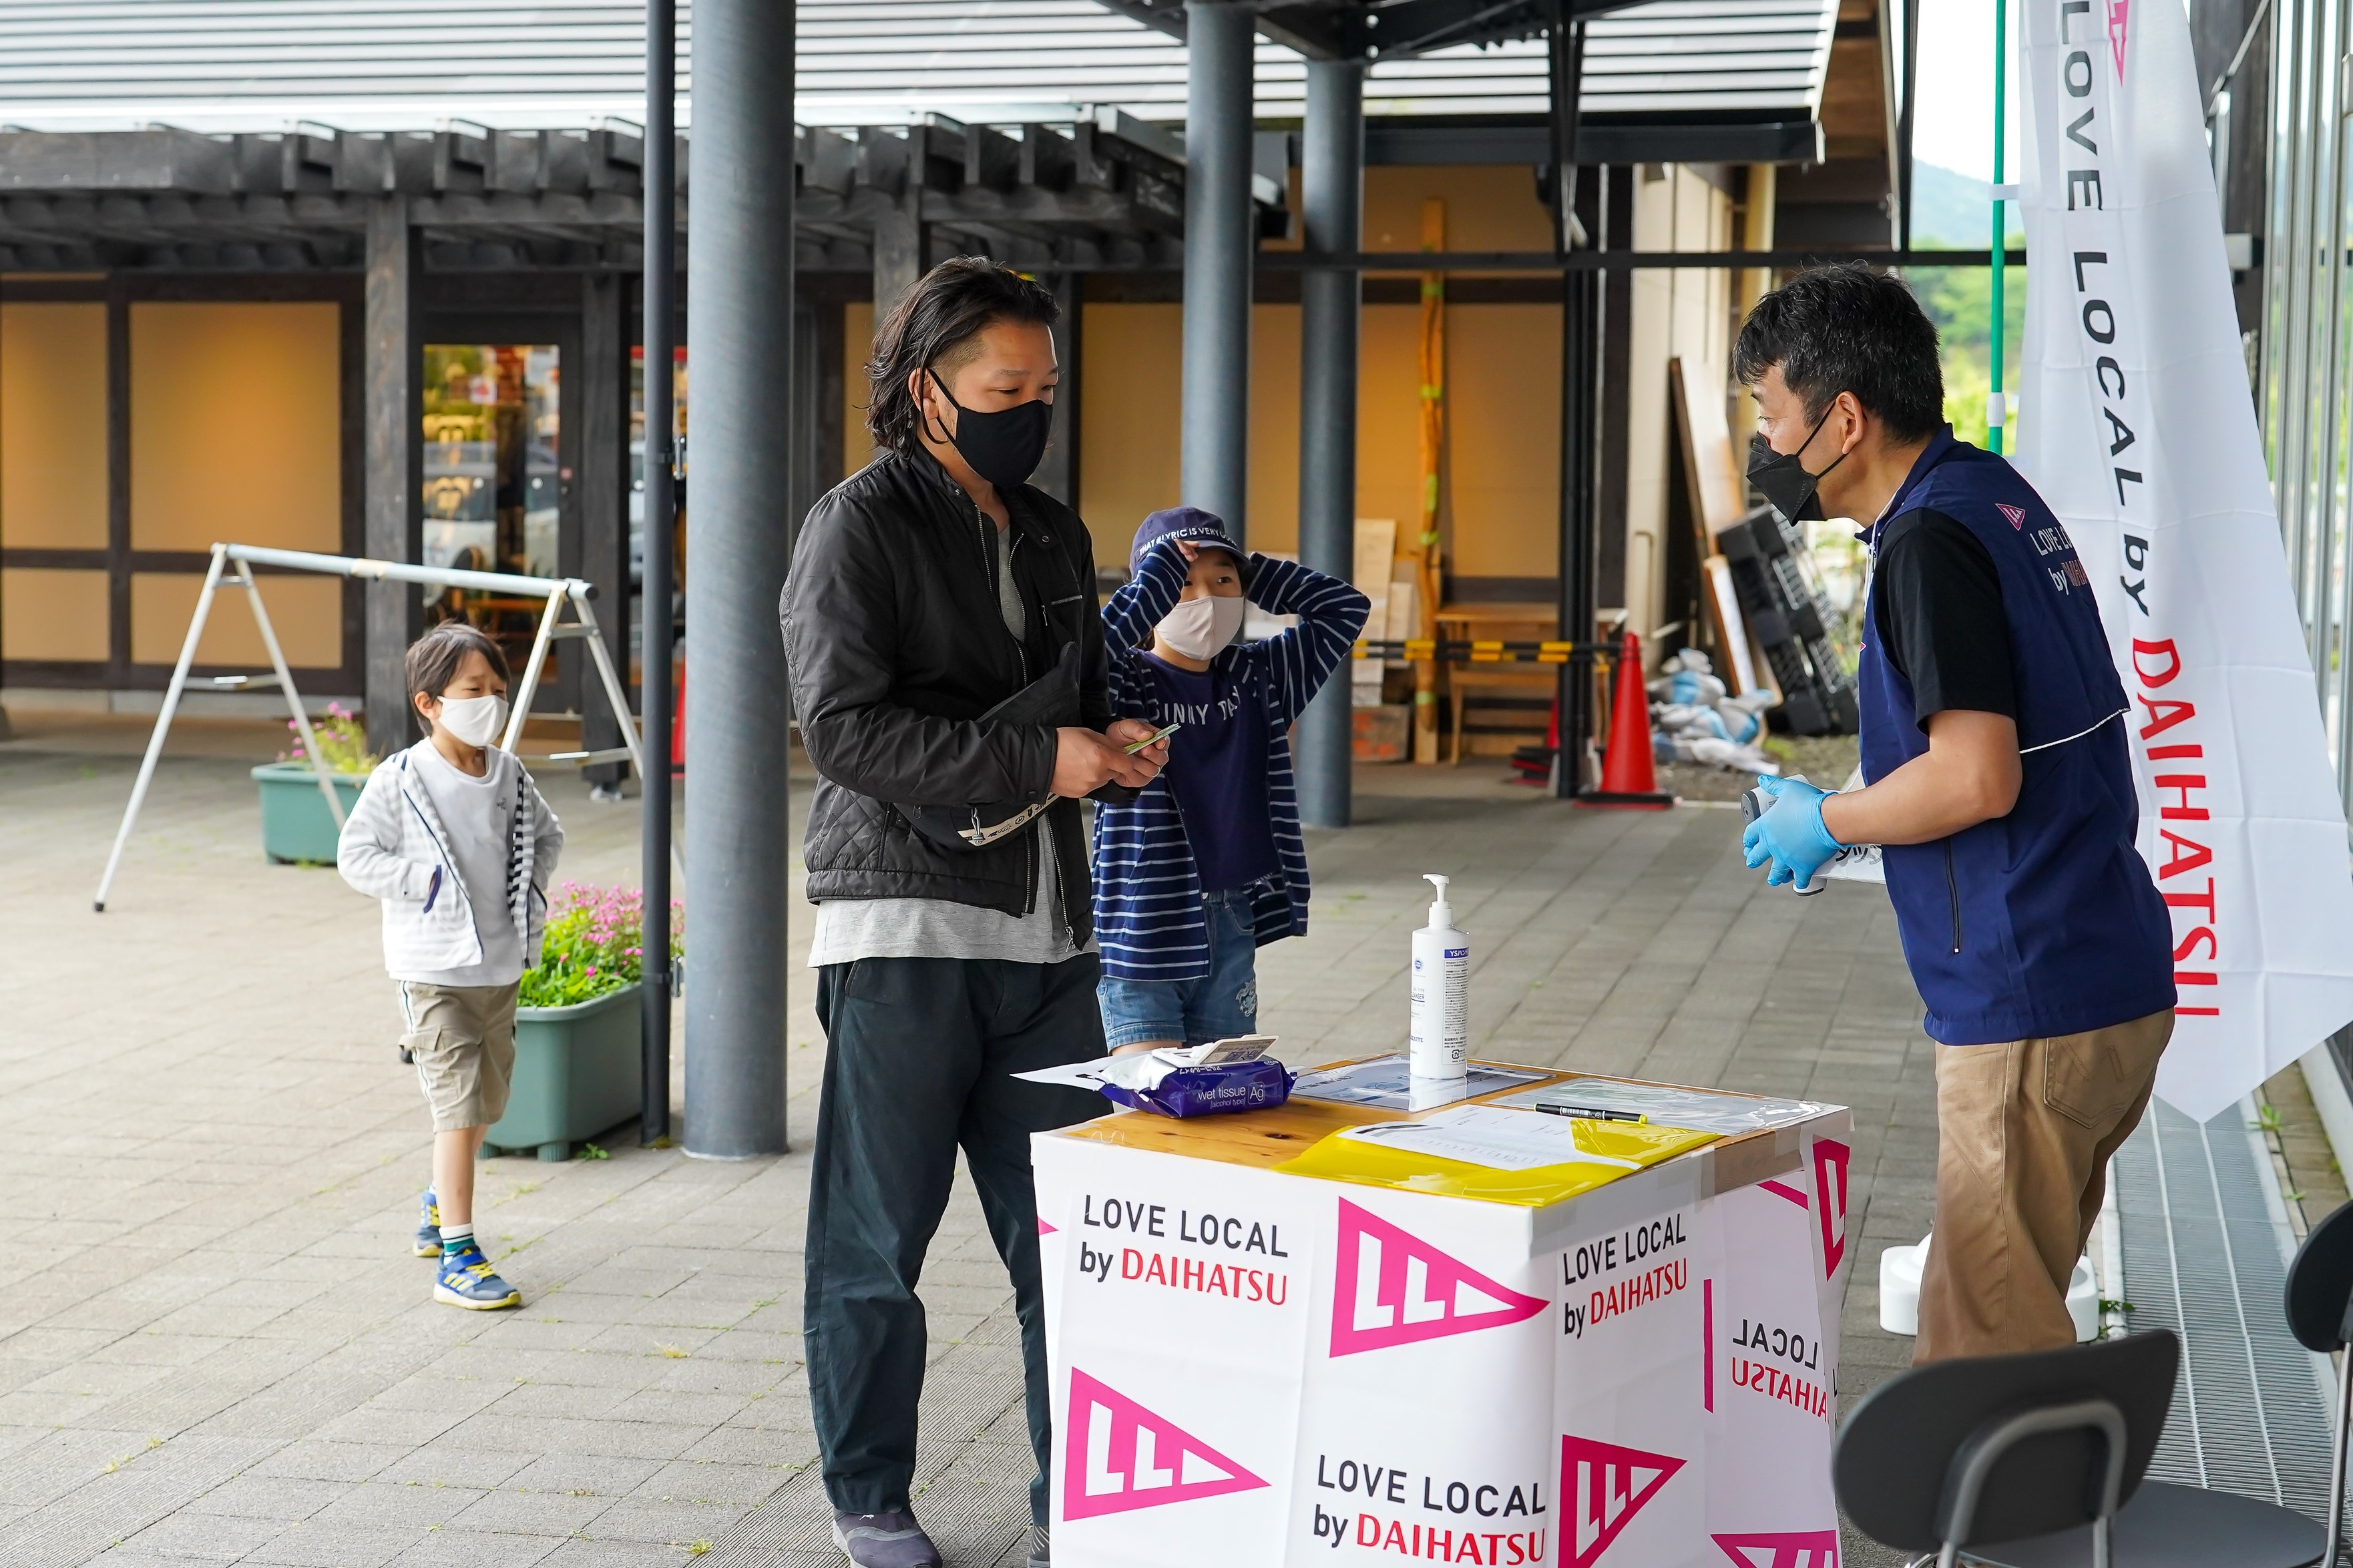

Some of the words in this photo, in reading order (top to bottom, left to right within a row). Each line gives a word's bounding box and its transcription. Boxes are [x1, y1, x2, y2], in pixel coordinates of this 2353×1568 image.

[2061, 1, 2103, 212] LOVE
[2073, 251, 2143, 507] LOCAL
[1189, 527, 1197, 536] IS
[1198, 527, 1219, 538] VERY
[2029, 527, 2063, 556] LOVE
[2047, 567, 2069, 595] by
[2121, 533, 2149, 617] by
[1198, 1088, 1216, 1101] wet
[1219, 1086, 1246, 1098] tissue
[1084, 1195, 1166, 1237] LOVE
[1181, 1210, 1288, 1258] LOCAL
[1563, 1236, 1617, 1285] LOVE
[1625, 1213, 1686, 1264] LOCAL
[1080, 1242, 1114, 1282] by
[1122, 1248, 1287, 1305] DAIHATSU
[1564, 1302, 1586, 1339] by
[1590, 1258, 1687, 1325] DAIHATSU
[1318, 1455, 1407, 1504] LOVE
[1424, 1477, 1546, 1517] LOCAL
[1313, 1504, 1348, 1548] by
[1357, 1513, 1545, 1566] DAIHATSU
